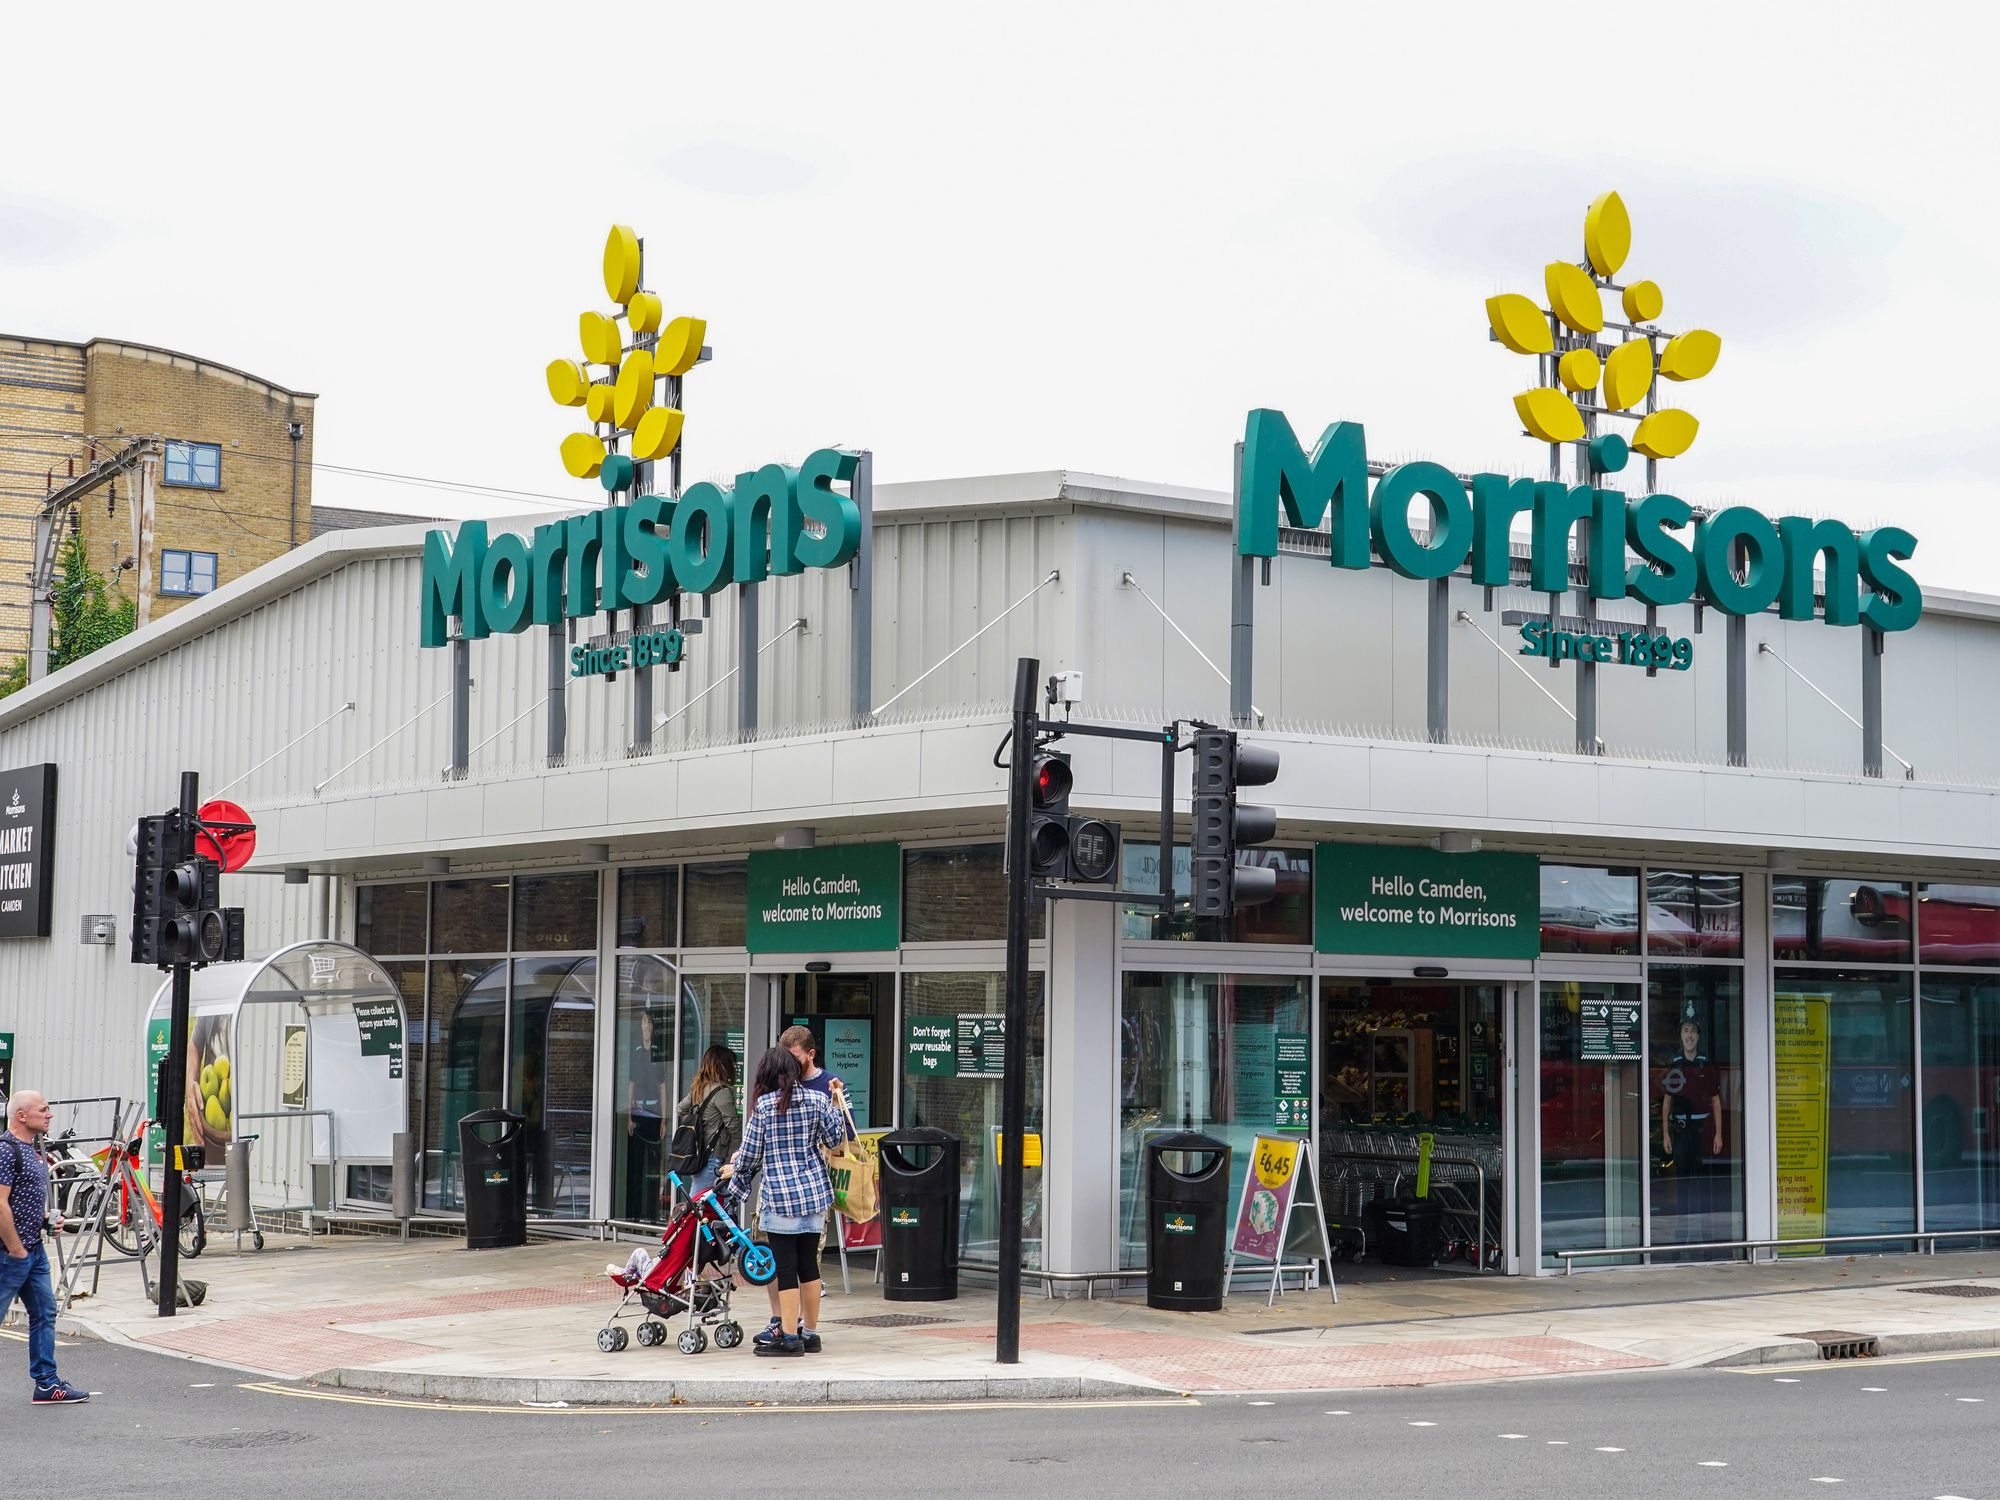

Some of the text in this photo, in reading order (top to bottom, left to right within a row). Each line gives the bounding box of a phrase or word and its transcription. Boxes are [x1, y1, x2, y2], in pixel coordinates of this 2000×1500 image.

[1238, 408, 1922, 632] Morrisons
[421, 448, 861, 648] Morrisons
[571, 628, 683, 677] Since 1899
[1520, 620, 1693, 671] Since 1899
[782, 874, 860, 896] Hello Camden,
[1372, 876, 1487, 902] Hello Camden,
[1, 900, 22, 912] CAMDEN
[762, 902, 881, 922] welcome to Morrisons
[1340, 902, 1516, 928] welcome to Morrisons
[1782, 1016, 1808, 1025] parking
[913, 1026, 951, 1039] Don't forget
[910, 1041, 951, 1053] your reusable
[923, 1055, 937, 1068] bags
[870, 1138, 876, 1146] 2
[1260, 1153, 1290, 1176] £6.45
[1794, 1196, 1816, 1204] validate
[893, 1216, 917, 1224] Morrisons
[1784, 1208, 1806, 1216] parking
